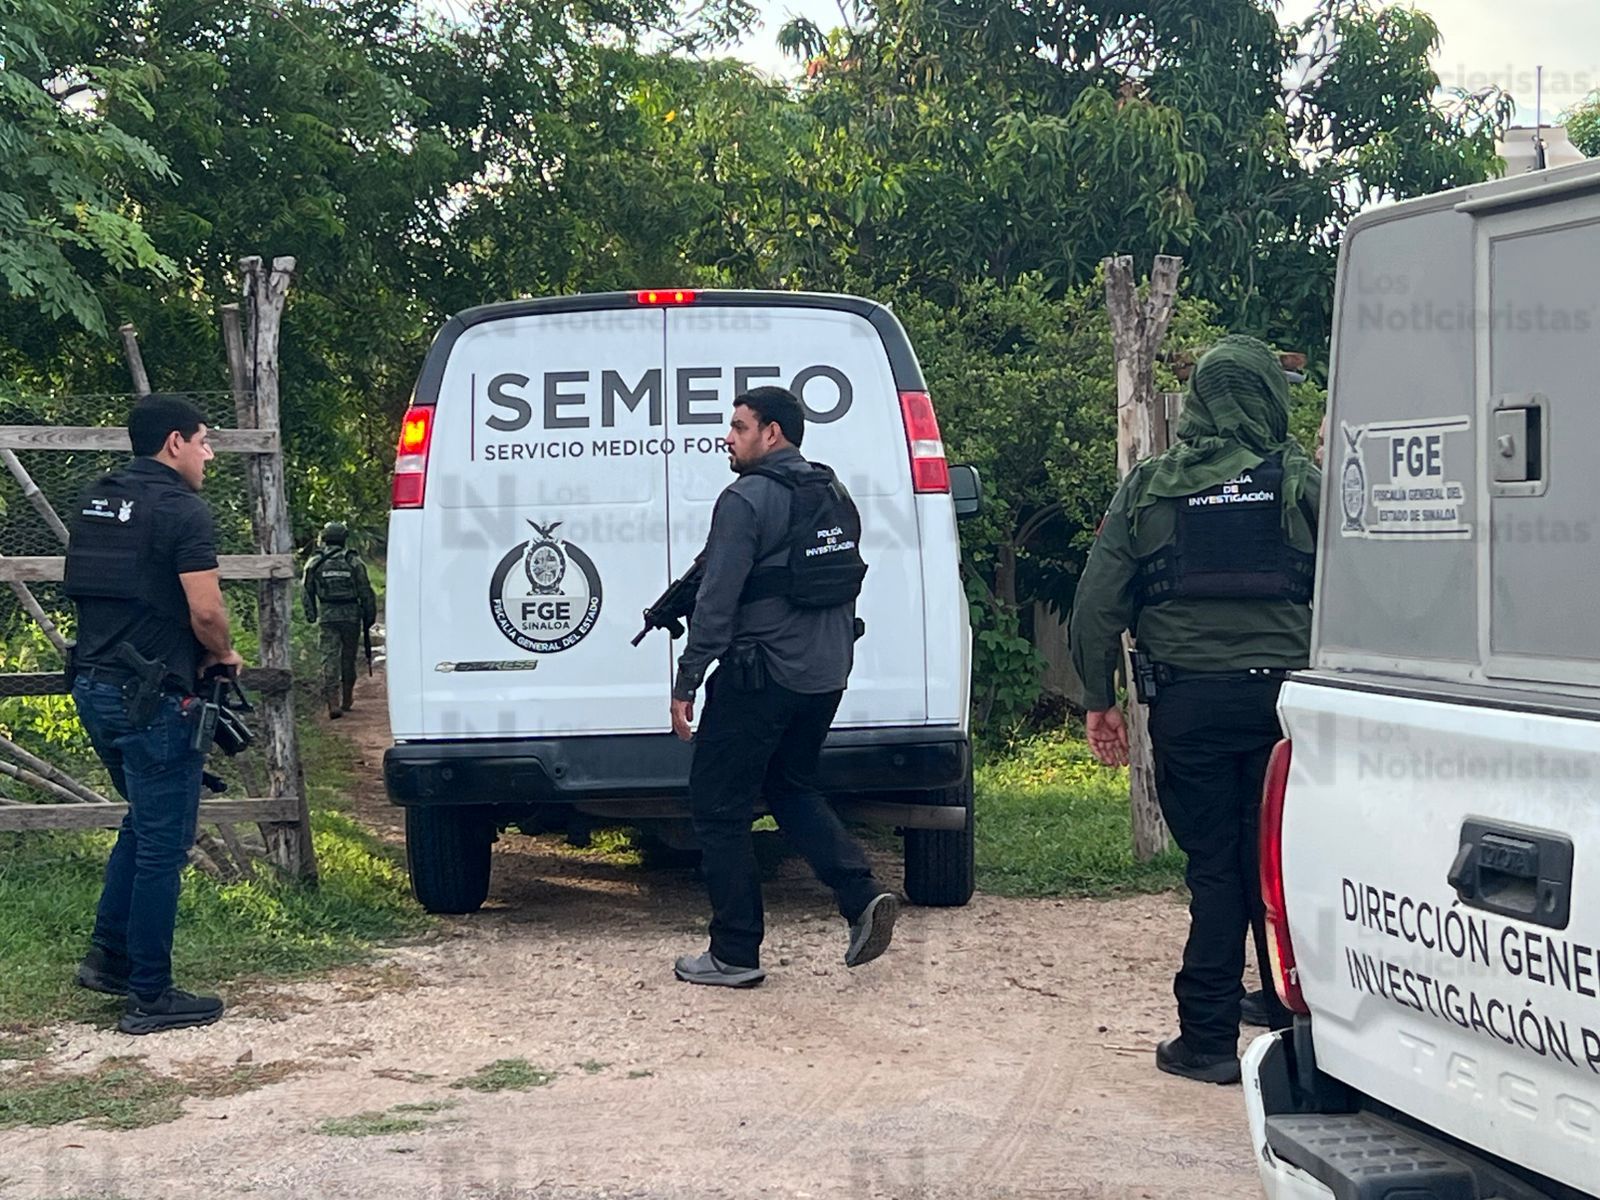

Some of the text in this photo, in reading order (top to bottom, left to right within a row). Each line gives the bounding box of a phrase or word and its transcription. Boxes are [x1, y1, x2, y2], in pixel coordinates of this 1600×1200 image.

[485, 436, 728, 461] SERVICIO MEDICO FOR
[1392, 435, 1441, 477] FGE
[1188, 490, 1274, 506] INVESTIGACIÓN
[1223, 485, 1239, 493] DE
[1410, 510, 1420, 521] DE
[521, 602, 571, 621] FGE
[516, 636, 561, 651] GENERAL
[562, 632, 581, 647] DEL
[579, 596, 600, 634] ESTADO
[521, 621, 571, 630] SINALOA
[1341, 878, 1600, 998] DIRECCIÓN GENE
[1345, 946, 1578, 1068] INVESTIGACIÓN
